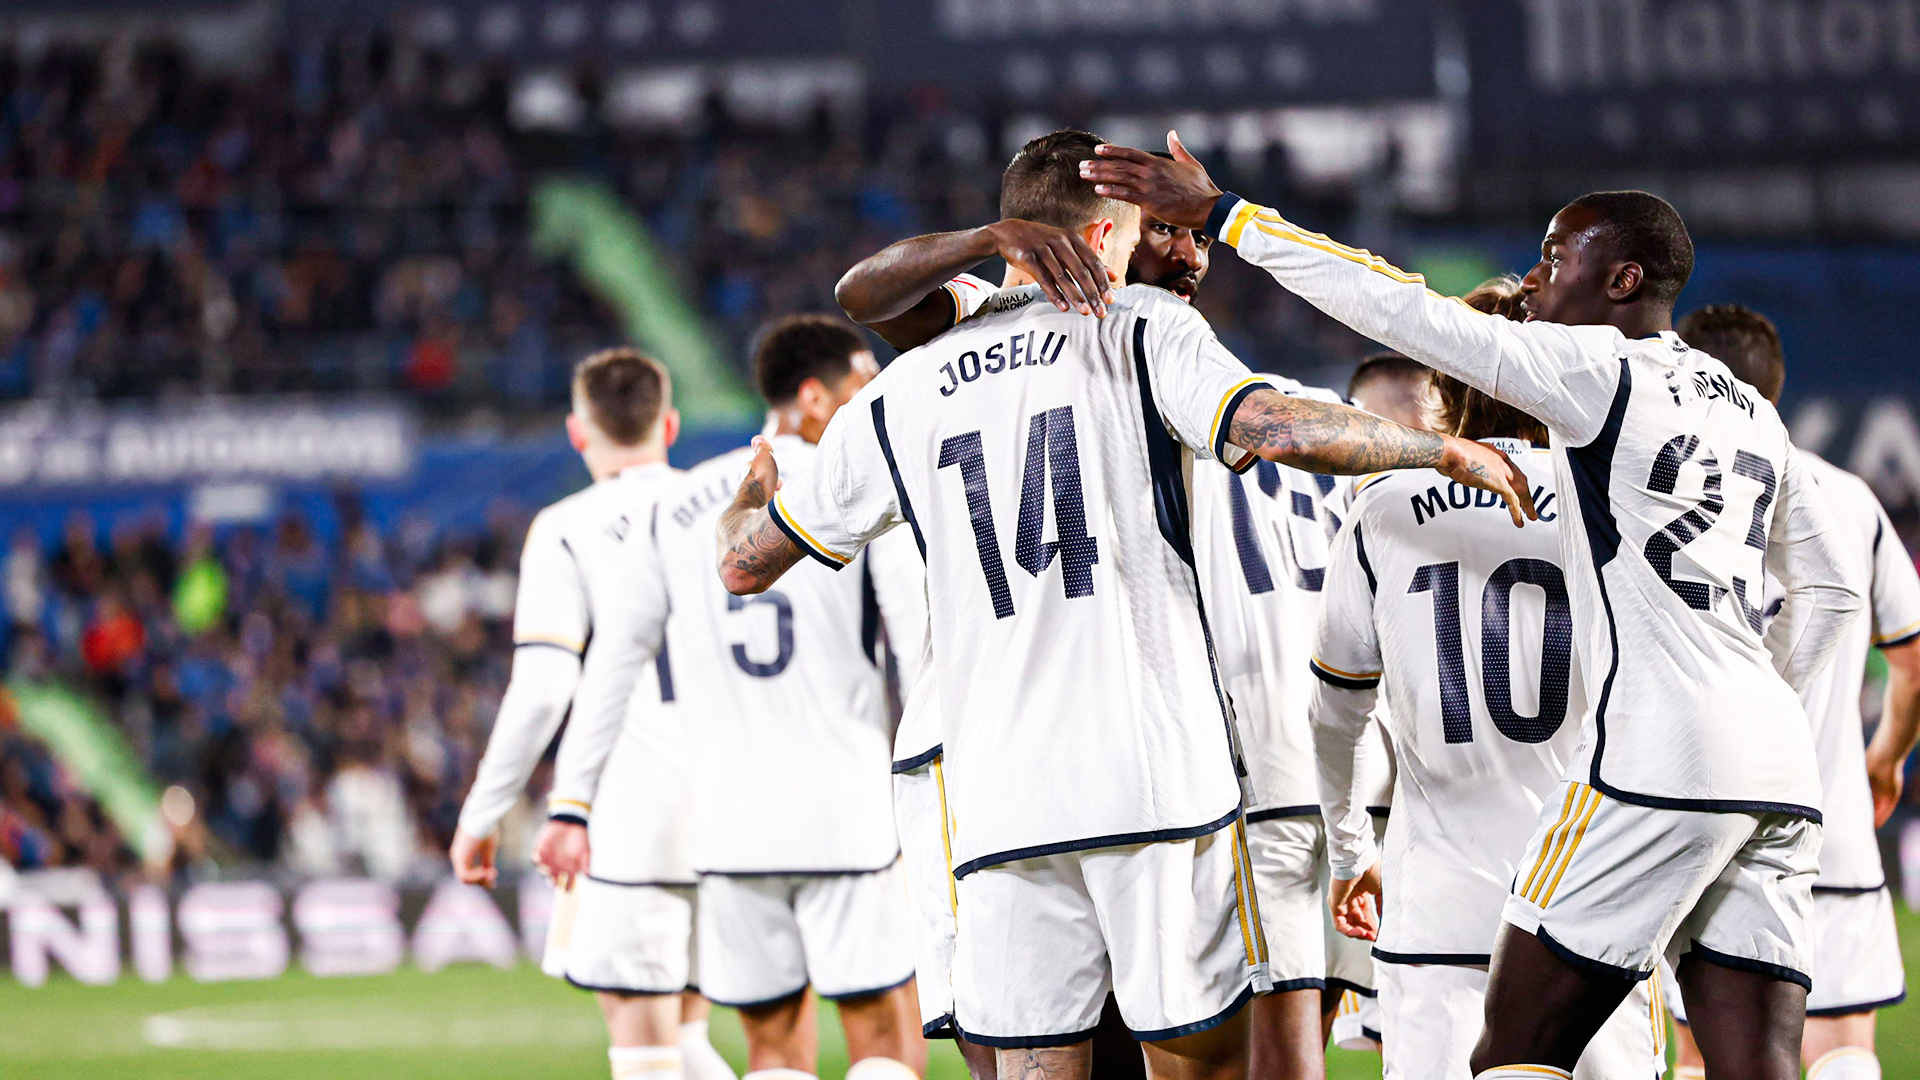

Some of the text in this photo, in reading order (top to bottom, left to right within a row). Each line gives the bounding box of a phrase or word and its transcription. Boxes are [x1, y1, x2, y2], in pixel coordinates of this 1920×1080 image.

[938, 330, 1068, 398] JOSELU
[937, 404, 1100, 621] 14
[1410, 480, 1558, 526] MODIC
[1643, 433, 1778, 638] 23
[727, 589, 795, 678] 5
[1406, 557, 1573, 745] 10
[7, 878, 548, 989] NISSA
